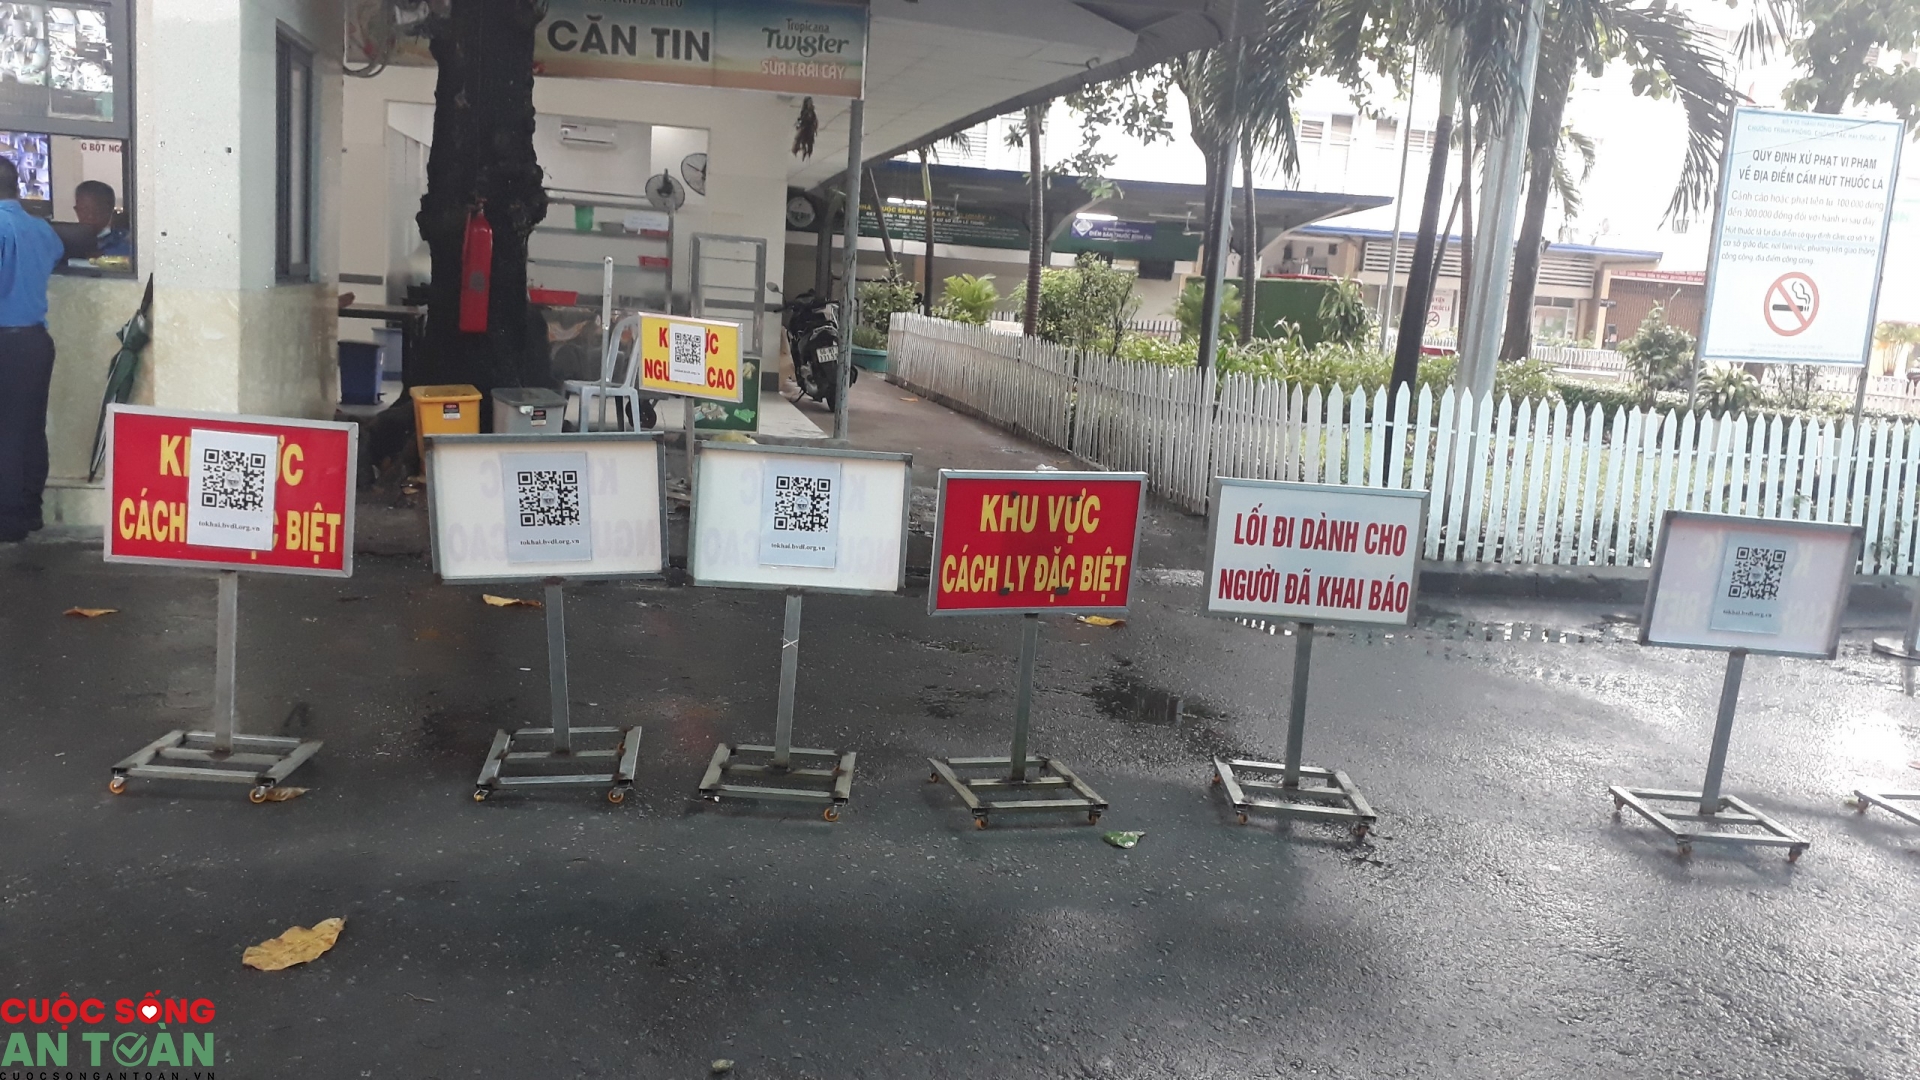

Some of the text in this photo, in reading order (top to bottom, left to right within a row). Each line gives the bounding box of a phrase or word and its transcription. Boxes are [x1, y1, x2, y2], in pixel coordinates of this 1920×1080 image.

[547, 14, 710, 62] CĂN TIN
[786, 18, 830, 33] Tropicana
[762, 27, 850, 57] Twister
[789, 60, 819, 77] TRÁI
[90, 140, 106, 153] BỘT
[1752, 149, 1877, 171] QUY ĐỊNH XỬ PHẠT VI PHẠM
[1739, 165, 1884, 190] VỀ ĐỊA ĐIỂM CẤM HÚT THUỐC LÁ
[1744, 208, 1772, 218] 300.000
[644, 358, 735, 390] NGU CAO
[119, 488, 186, 542] CÁCH
[286, 502, 341, 564] BIỆT
[980, 488, 1101, 544] KHU VỰC
[1234, 503, 1408, 557] LỐI ĐI DÀNH CHO
[942, 544, 1127, 602] CÁCH LY ĐẶC BIỆT
[1218, 563, 1410, 613] NGƯỜI ĐÃ KHAI BÁO
